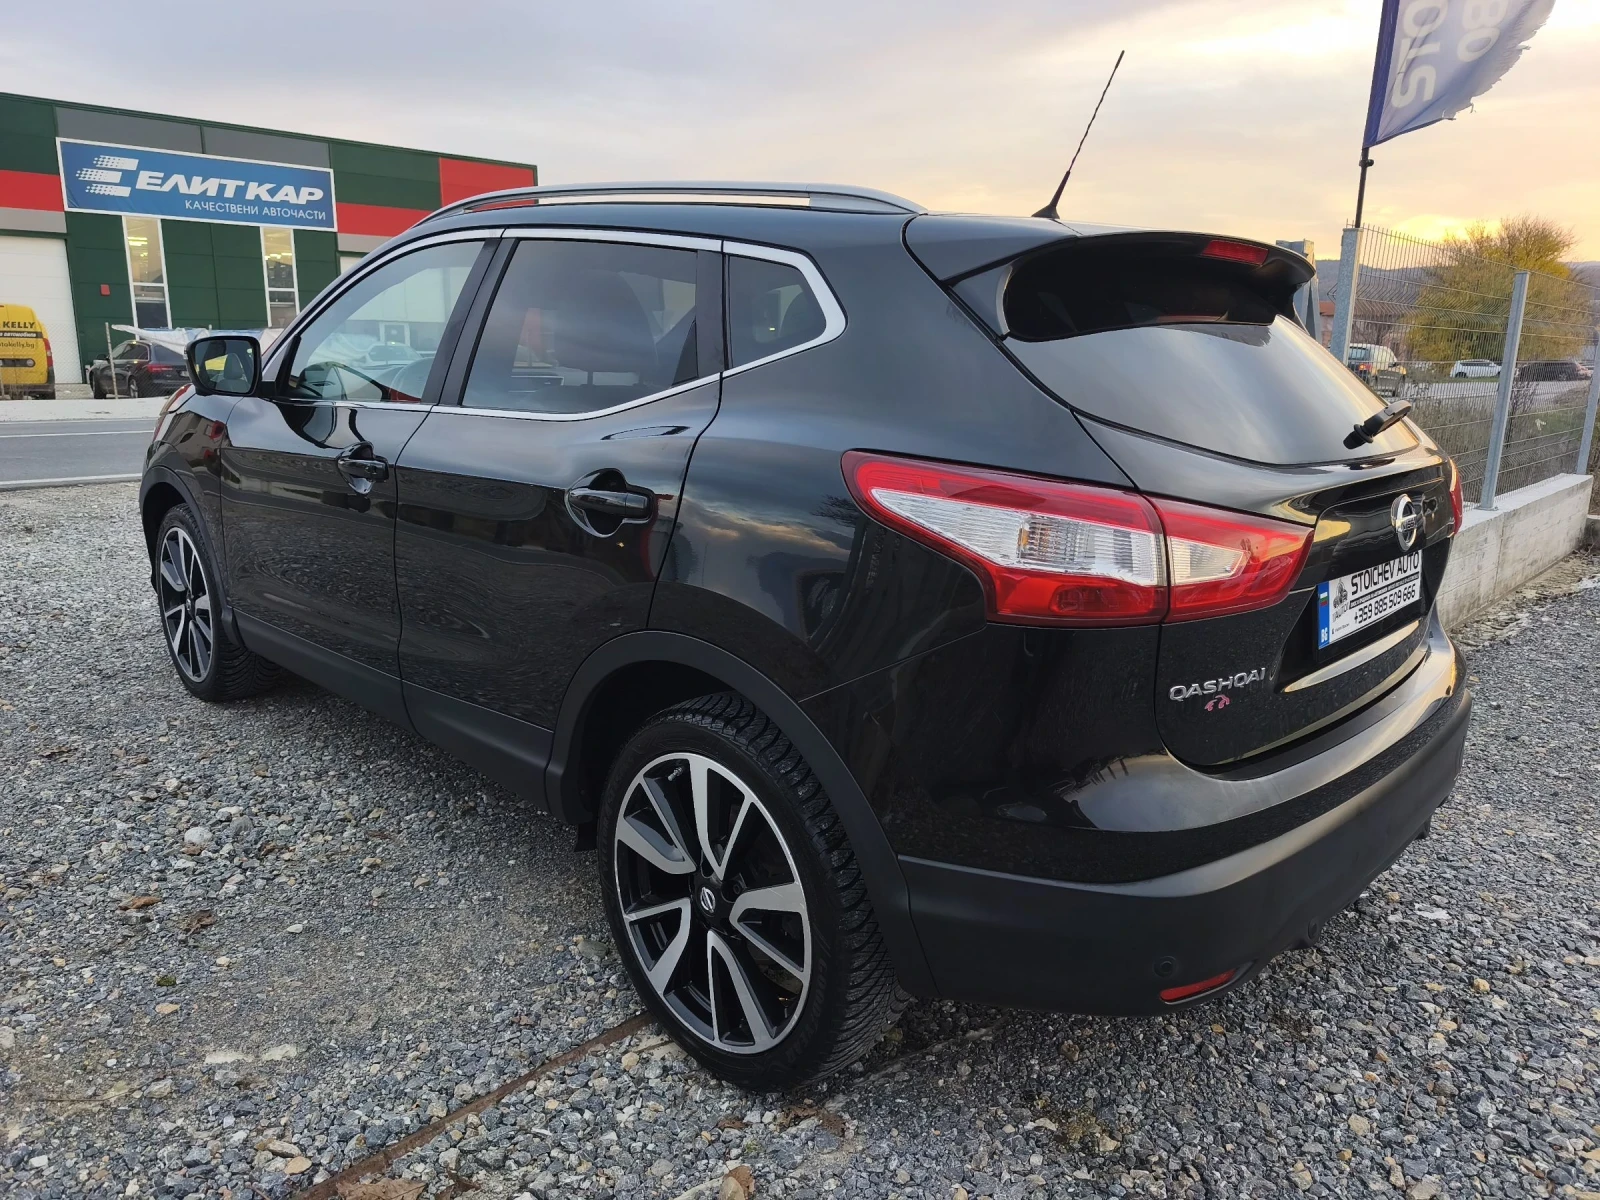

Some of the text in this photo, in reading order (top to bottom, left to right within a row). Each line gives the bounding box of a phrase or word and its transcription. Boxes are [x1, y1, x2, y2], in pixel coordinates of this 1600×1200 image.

[185, 199, 326, 220] КАЧЕСТВЕНИ АВТОЧАСТИ
[0, 341, 34, 349] tokelly.bg
[1351, 560, 1395, 596] STOICHEV
[1396, 550, 1419, 577] AUTO
[1354, 603, 1373, 624] +359
[1389, 589, 1402, 609] 509
[1321, 627, 1328, 643] BG
[1169, 667, 1266, 701] QASHQAI
